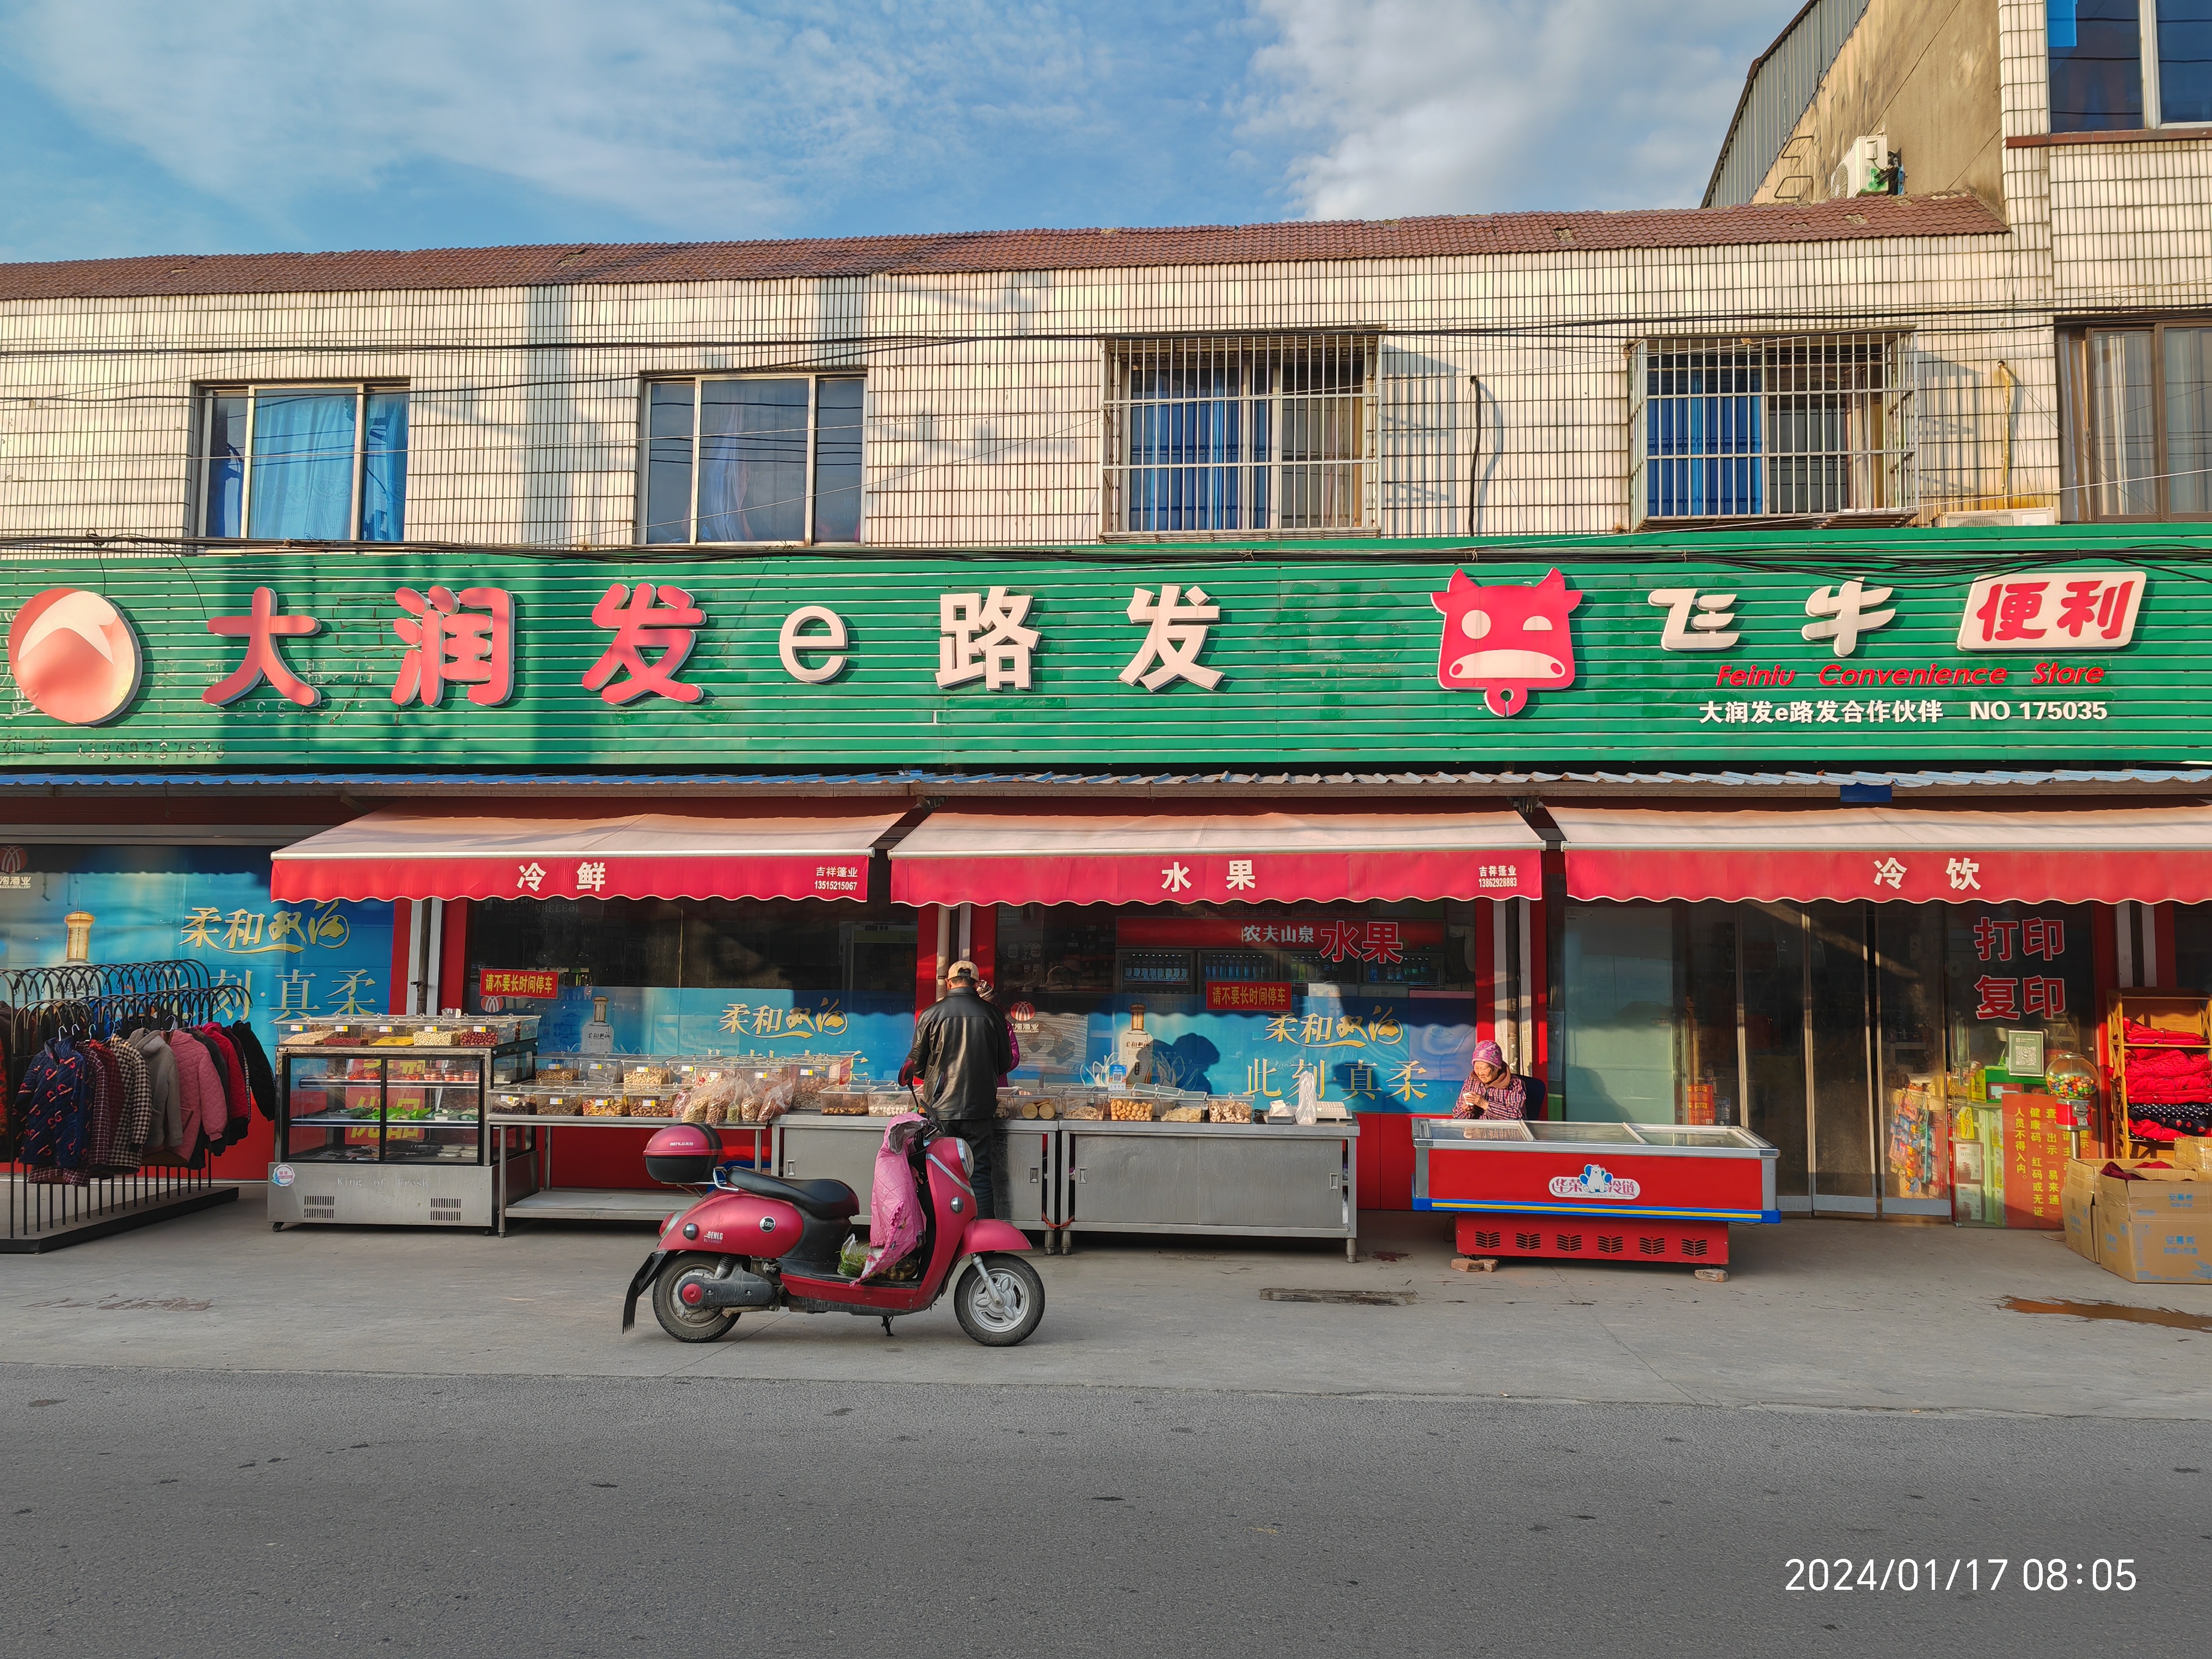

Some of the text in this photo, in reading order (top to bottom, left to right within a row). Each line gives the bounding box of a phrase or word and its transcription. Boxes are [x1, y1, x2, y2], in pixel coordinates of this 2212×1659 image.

[1976, 579, 2136, 642] 便利
[201, 582, 1226, 708] 大润发e路发
[1716, 661, 2105, 686] Feiniu Convenience Store
[1699, 699, 2108, 725] 大润发e路发合作伙伴 NO 175035
[516, 861, 606, 893] 冷鲜
[815, 866, 858, 877] 吉祥篷业
[1160, 859, 1256, 893] 水果
[1478, 865, 1517, 877] 吉祥篷业
[1478, 877, 1517, 888] 13862928883
[1872, 856, 1982, 890] 冷饮
[814, 880, 858, 891] 13515215067
[1243, 925, 1314, 944] 农夫山泉
[1318, 920, 1404, 964] 水果
[1973, 916, 2065, 962] 打印
[485, 973, 553, 994] 请不要长时间停车
[1212, 985, 1287, 1007] 请不要长时间停车
[1973, 975, 2066, 1021] 复印
[336, 1177, 428, 1187] King of Fresh
[1551, 1178, 1636, 1197] 华荣冷链
